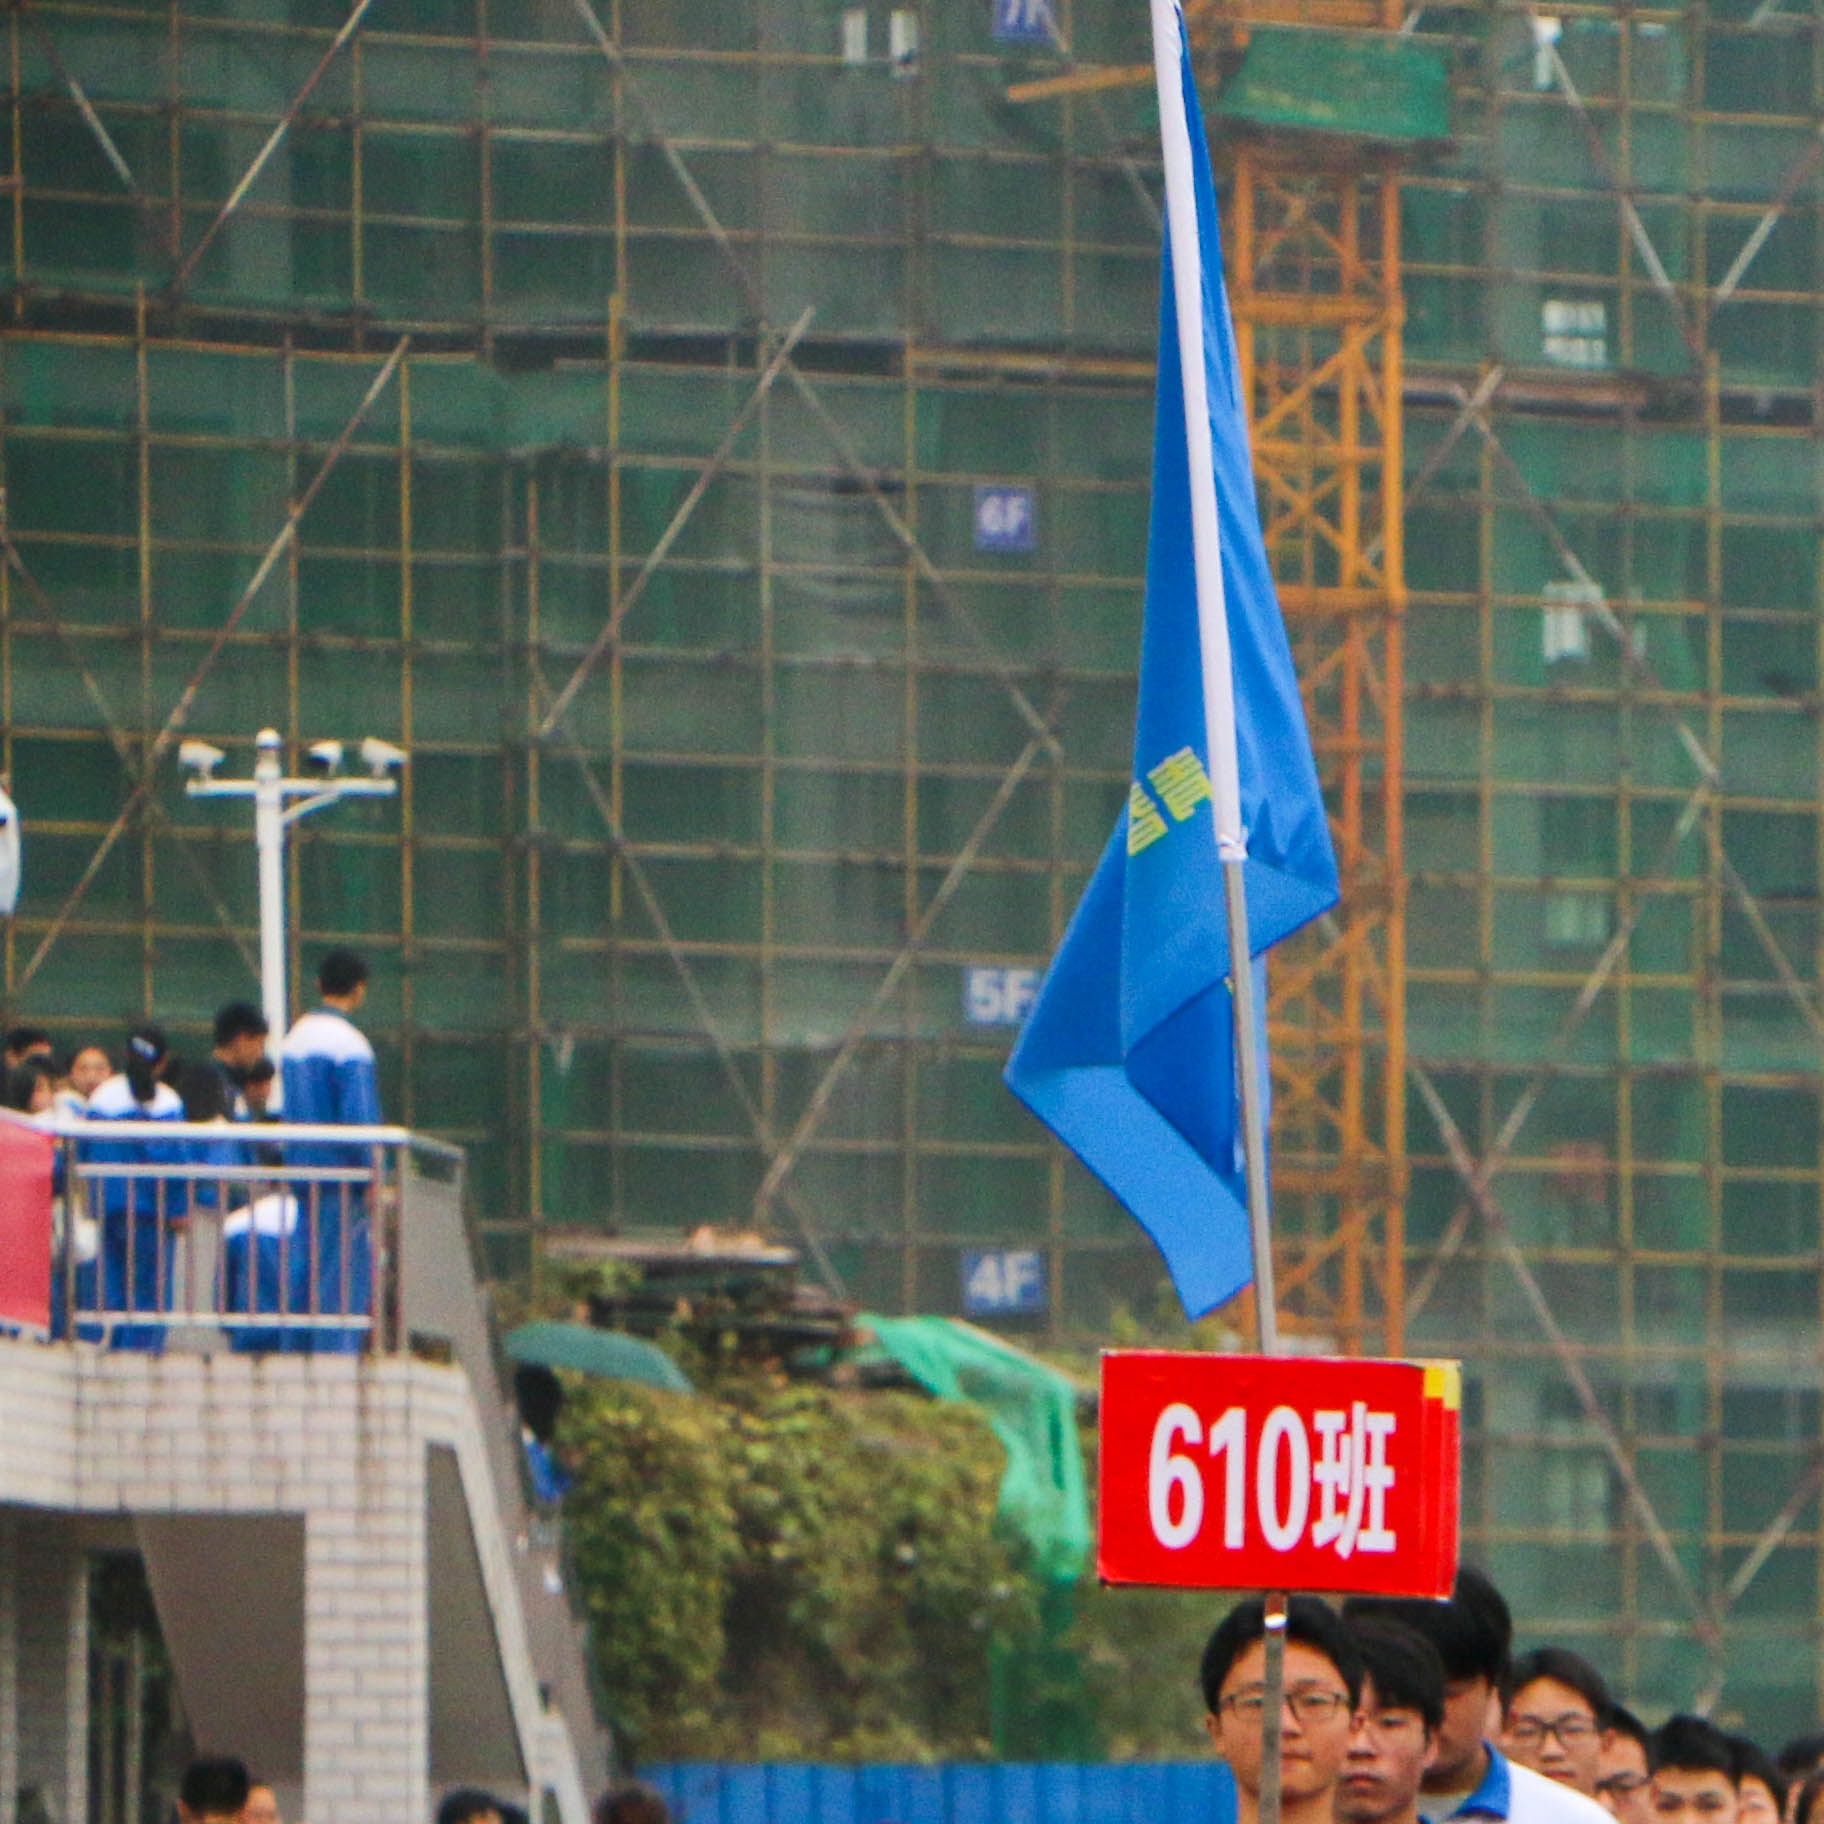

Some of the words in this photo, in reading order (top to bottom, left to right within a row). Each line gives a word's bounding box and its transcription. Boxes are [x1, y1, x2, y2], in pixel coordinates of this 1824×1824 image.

[970, 968, 1035, 1021] 5F
[968, 1251, 1035, 1306] 4F
[1148, 1401, 1398, 1560] 610班
